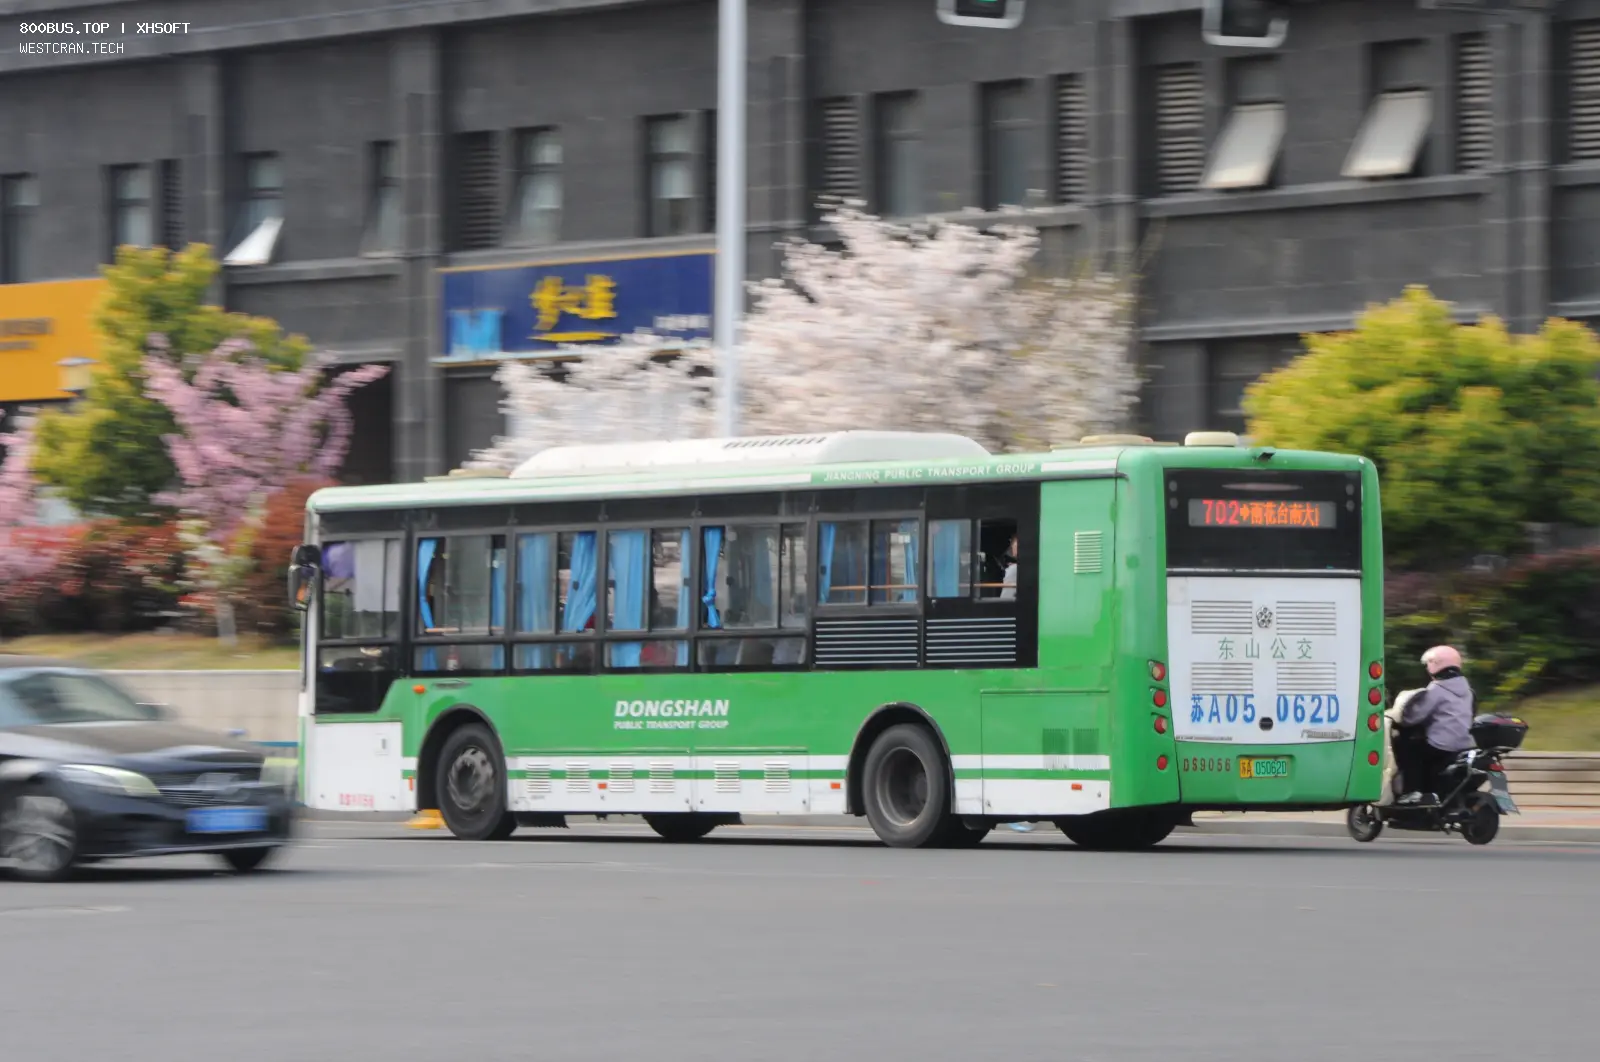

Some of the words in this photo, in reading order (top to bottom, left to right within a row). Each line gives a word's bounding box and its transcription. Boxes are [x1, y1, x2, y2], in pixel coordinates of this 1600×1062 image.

[823, 469, 880, 482] JIANGNING
[884, 467, 923, 479] PUBLIC
[928, 465, 991, 477] TRANSPORT
[996, 463, 1036, 474] GROUP
[1202, 499, 1240, 525] 702
[1217, 637, 1313, 660] 东山公交
[614, 699, 730, 718] DONGSHAN
[1190, 693, 1256, 724] 苏A05
[1276, 693, 1341, 724] 062D
[646, 720, 696, 729] TRANSPORT
[698, 720, 729, 729] GROUP
